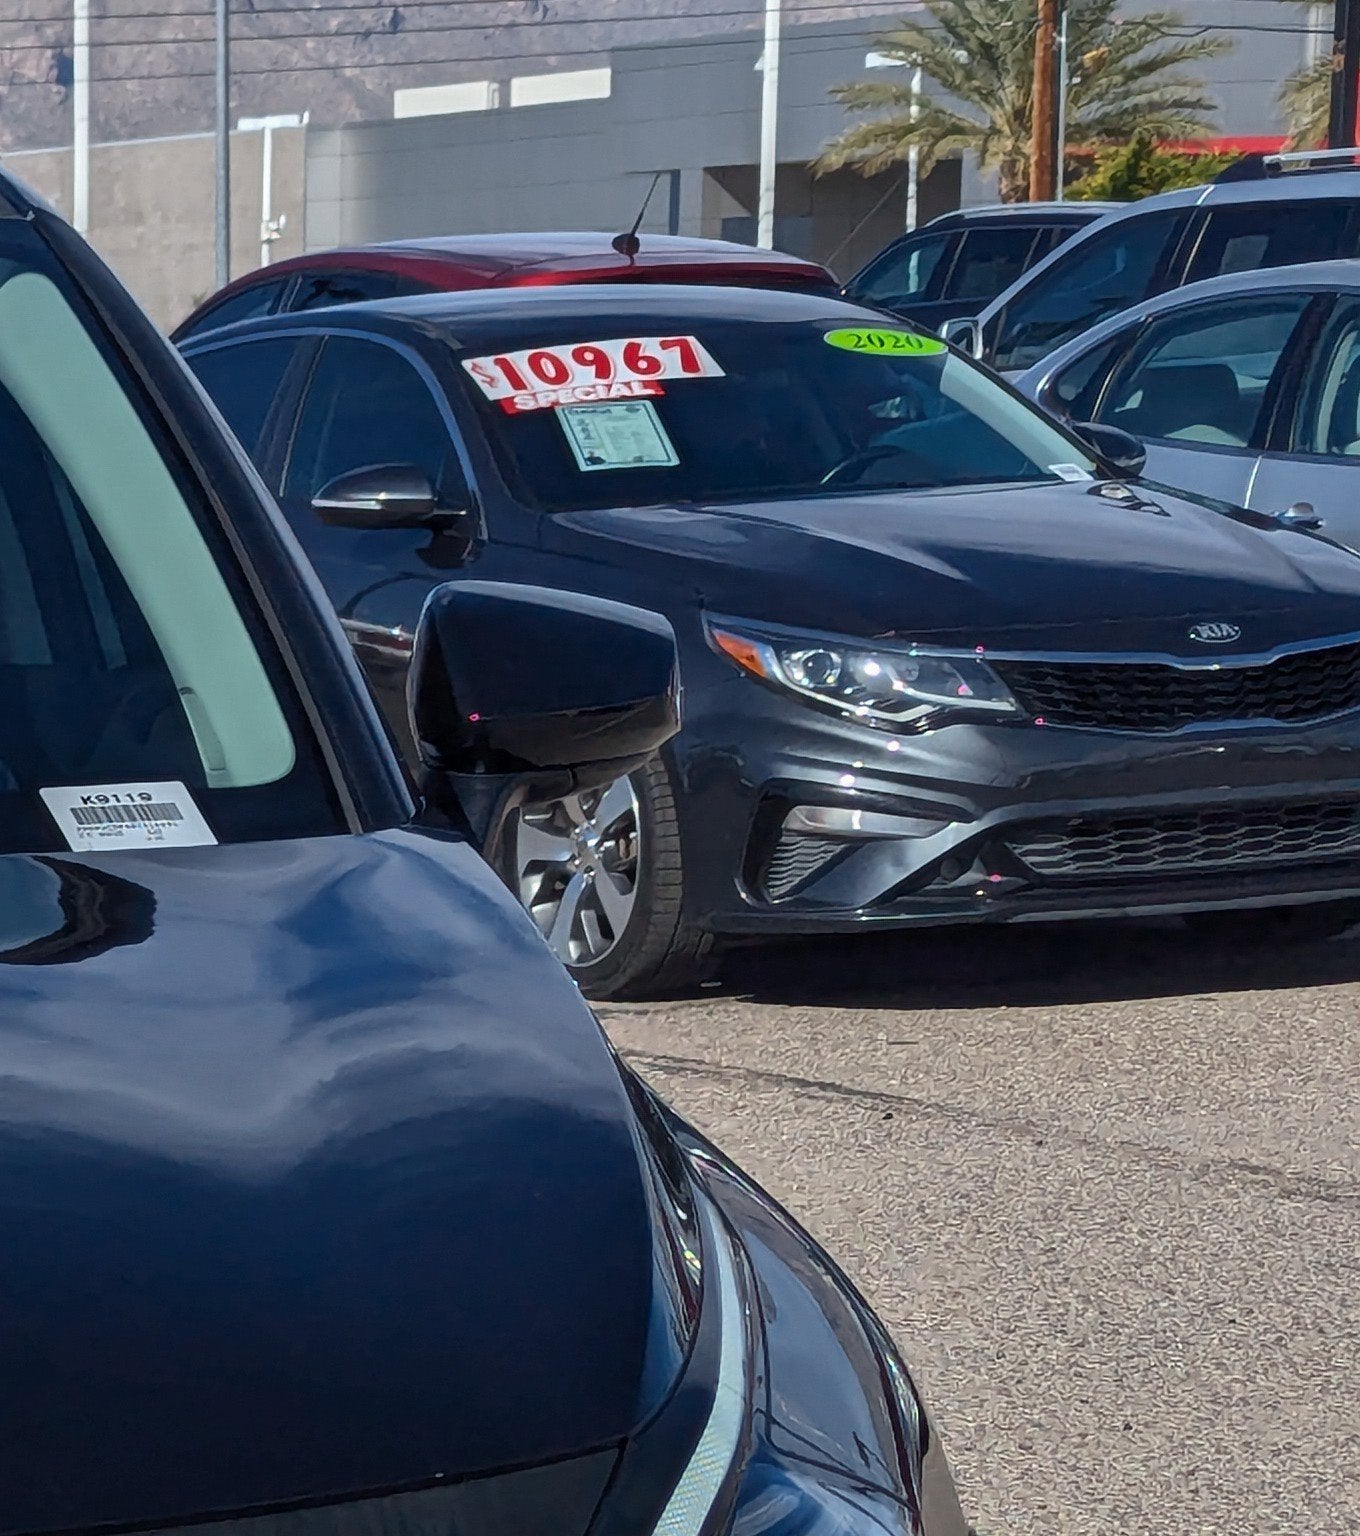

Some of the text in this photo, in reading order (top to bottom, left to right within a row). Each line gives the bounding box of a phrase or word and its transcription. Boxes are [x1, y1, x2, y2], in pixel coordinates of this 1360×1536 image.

[848, 333, 924, 349] 2020
[470, 337, 702, 392] $10967
[513, 379, 656, 411] SPECIAL
[1196, 622, 1238, 639] KIA
